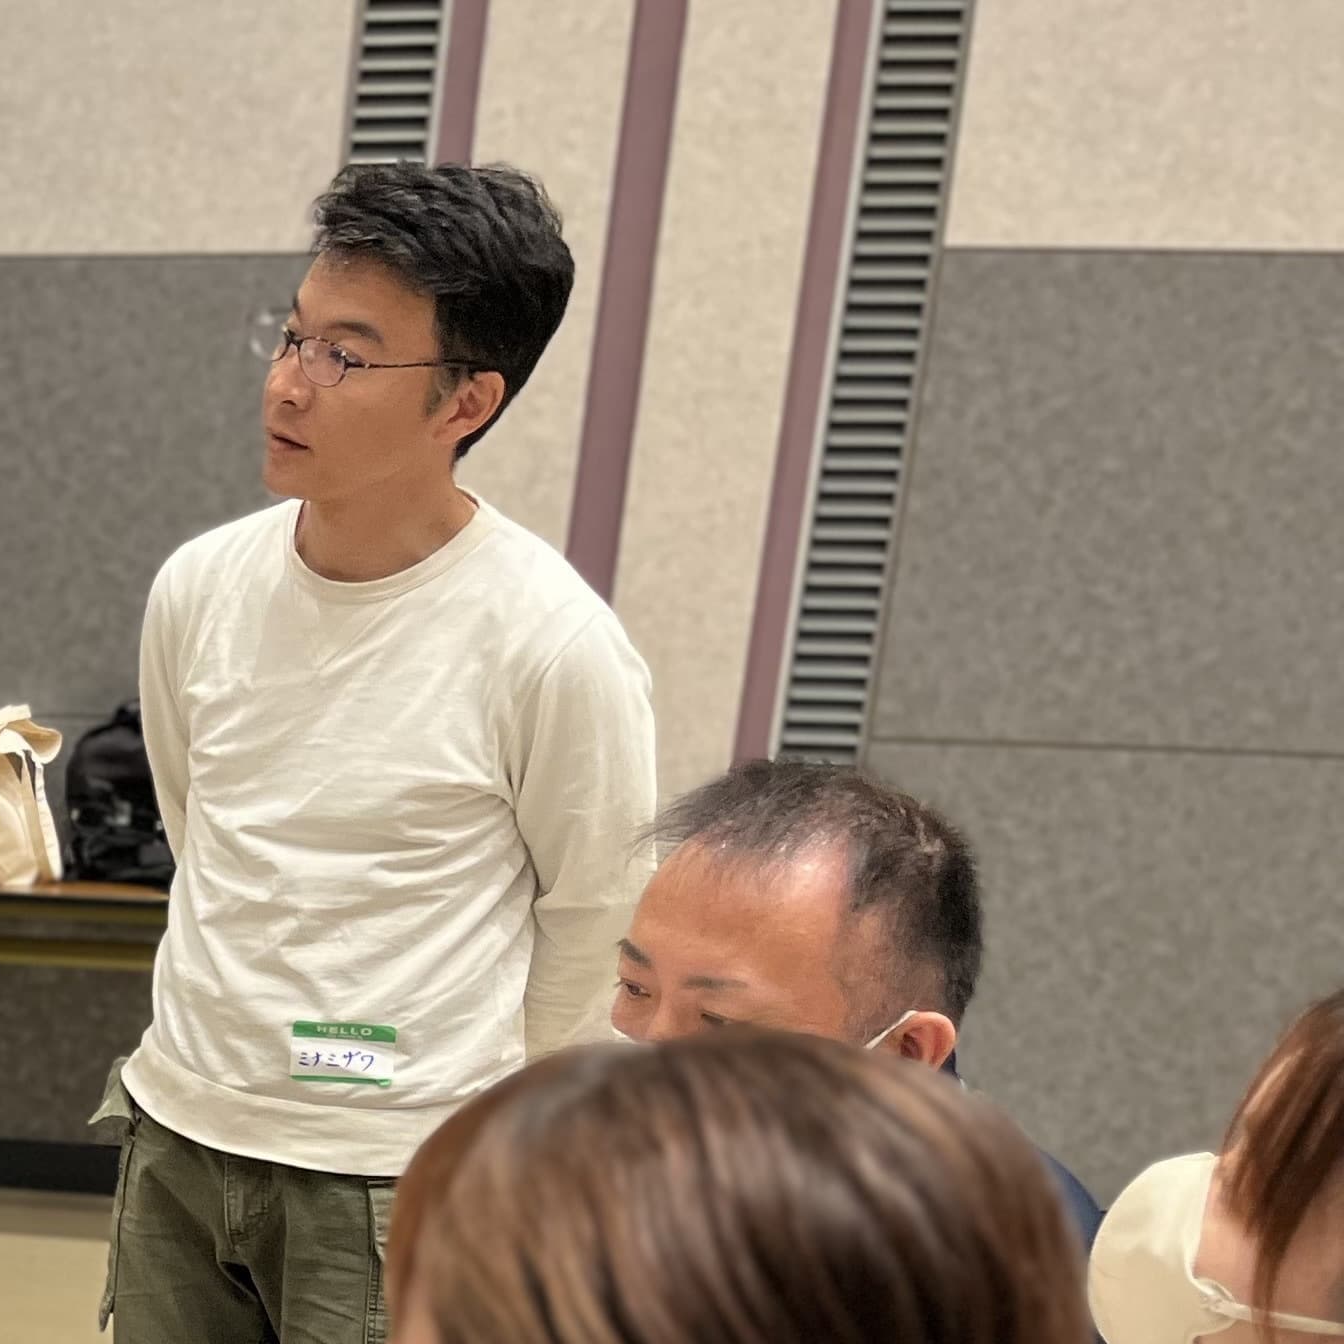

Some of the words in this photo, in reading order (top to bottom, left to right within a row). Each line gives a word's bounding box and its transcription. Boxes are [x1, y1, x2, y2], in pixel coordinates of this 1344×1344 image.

[316, 1025, 373, 1036] HELLO
[298, 1050, 375, 1072] ミナミザワ
